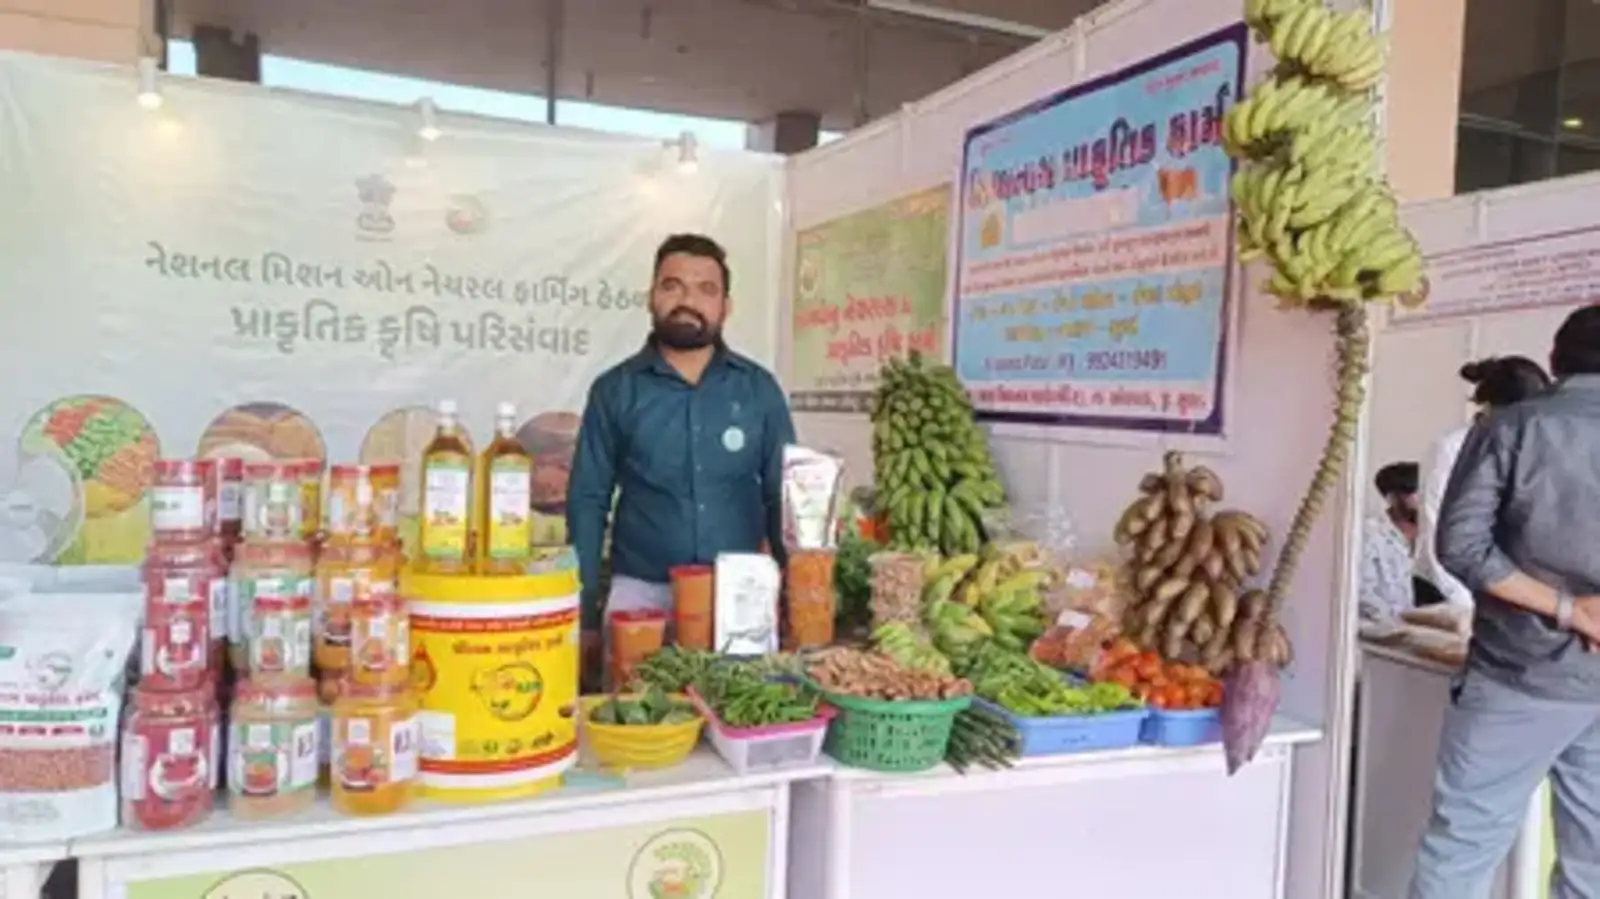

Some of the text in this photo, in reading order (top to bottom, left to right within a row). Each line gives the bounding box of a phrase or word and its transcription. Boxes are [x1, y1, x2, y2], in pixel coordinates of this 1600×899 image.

[144, 240, 252, 283] નેશનલ
[262, 251, 345, 288] મિશન
[352, 259, 415, 293] ઓન
[421, 263, 504, 300] નેચરલ
[231, 298, 590, 359] પ્રાકૃતિક કૃષિ પરિસંવાદ
